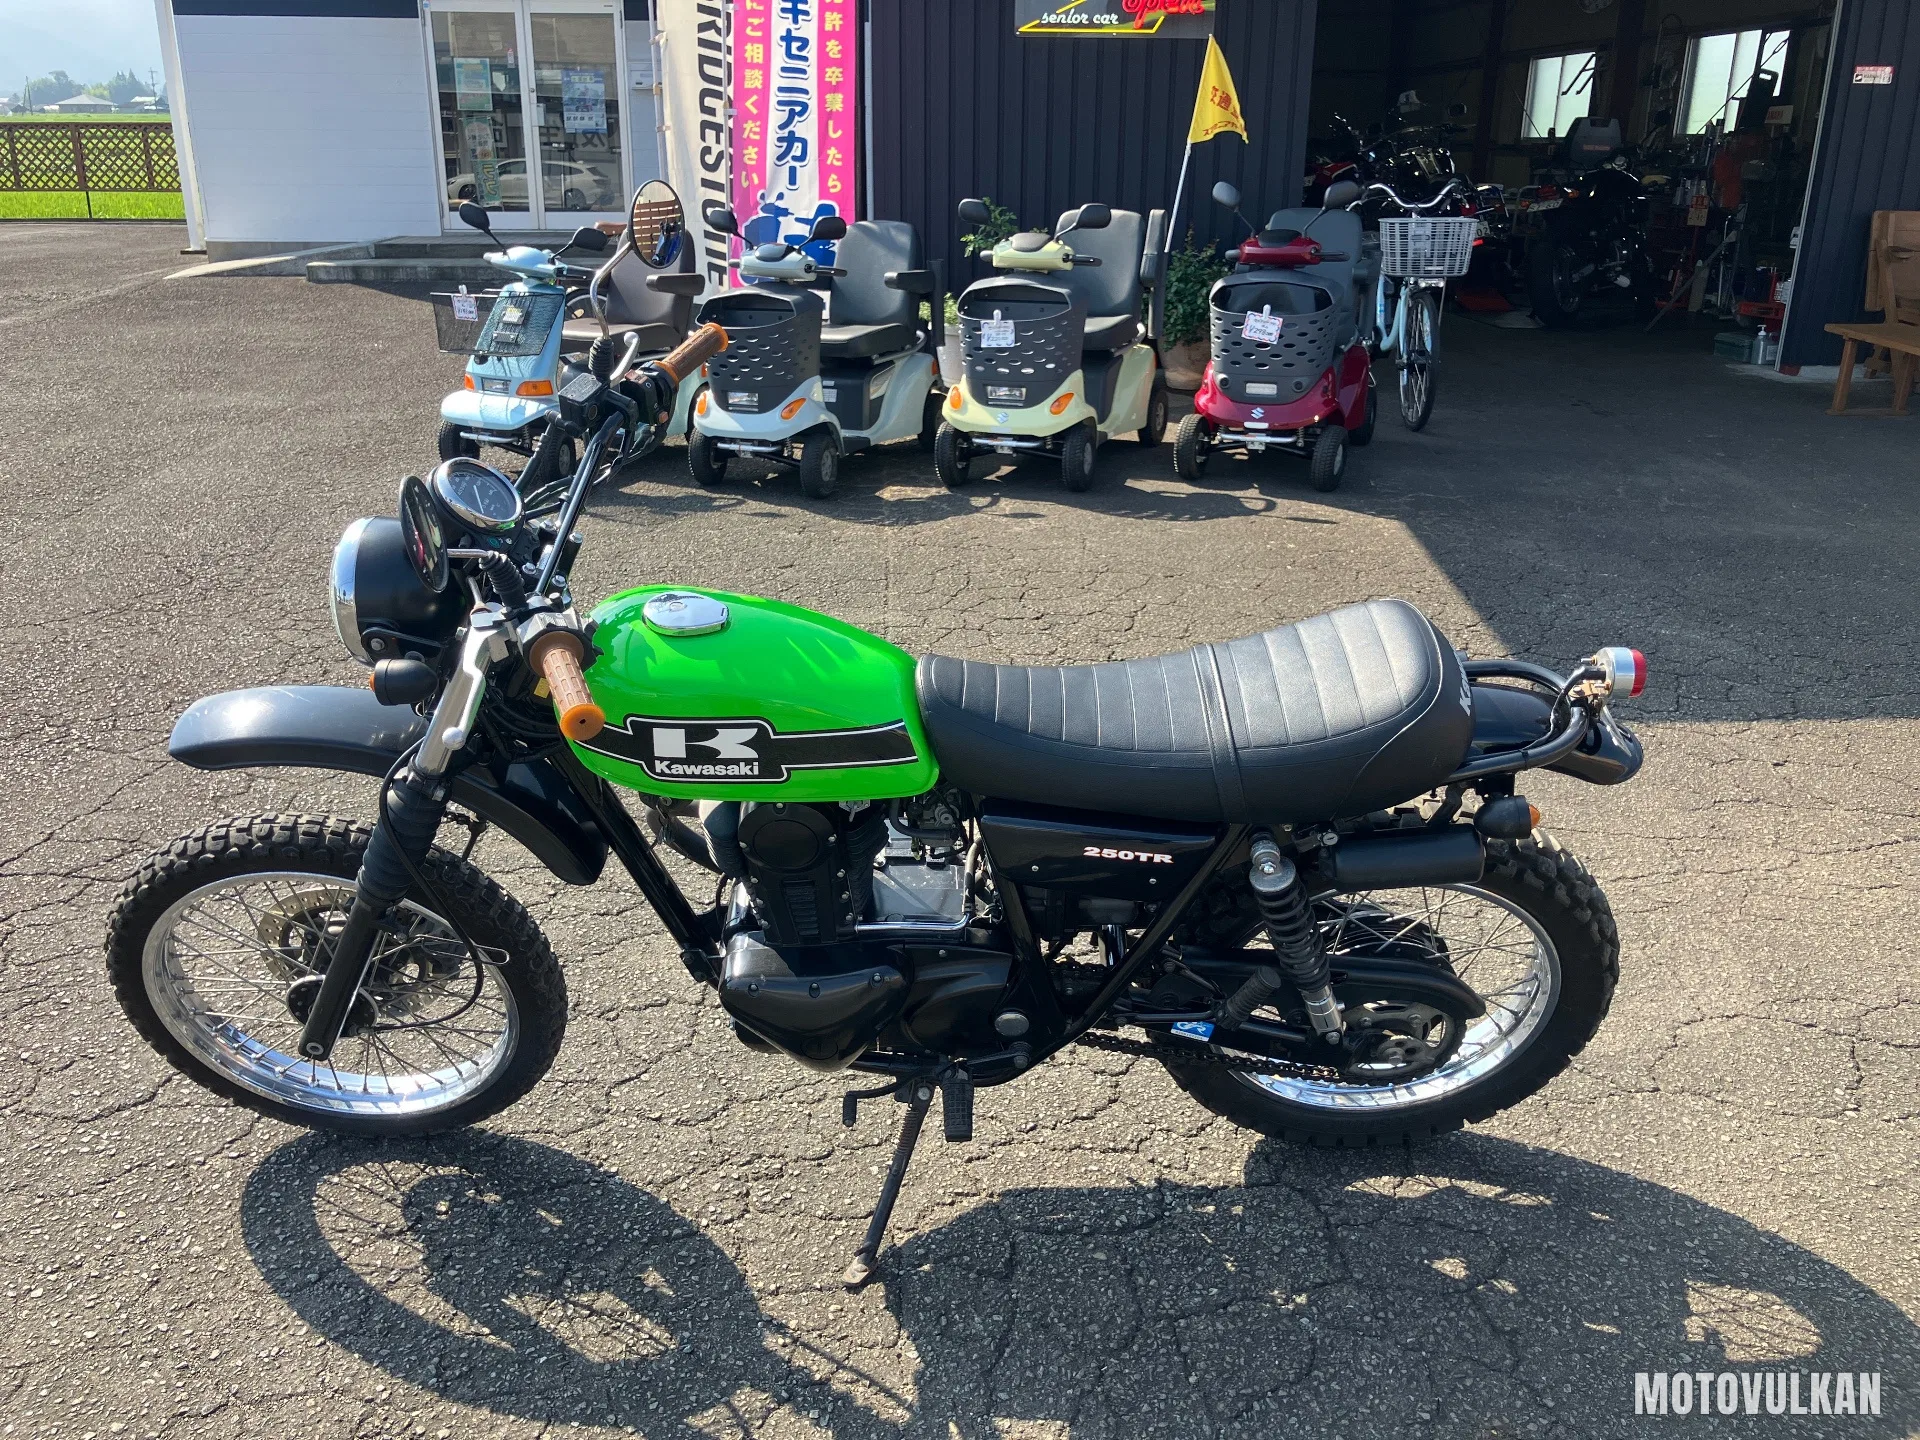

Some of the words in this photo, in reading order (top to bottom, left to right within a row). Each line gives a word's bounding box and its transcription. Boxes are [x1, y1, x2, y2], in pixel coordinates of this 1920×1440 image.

[1041, 8, 1089, 24] senior
[1093, 13, 1119, 24] car
[824, 0, 843, 193] 許を卒業したら
[655, 760, 759, 775] Kawasaki
[1083, 846, 1174, 863] 250TR
